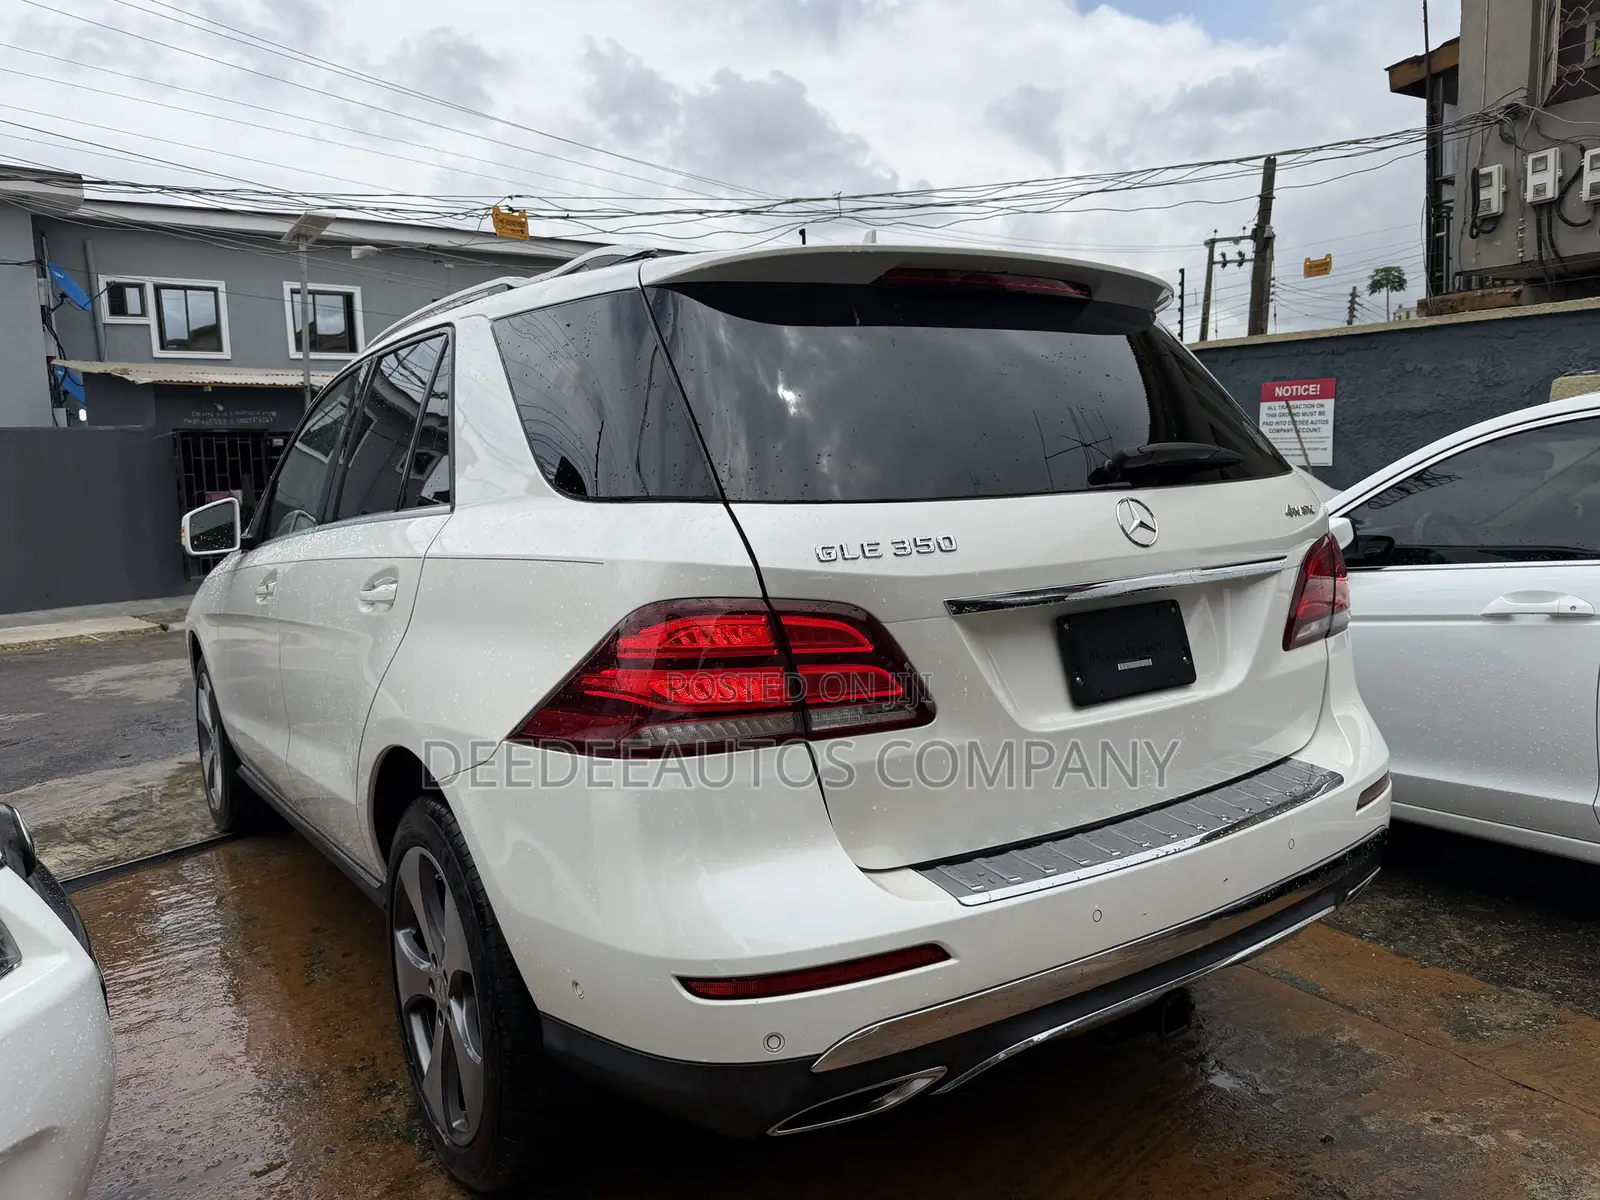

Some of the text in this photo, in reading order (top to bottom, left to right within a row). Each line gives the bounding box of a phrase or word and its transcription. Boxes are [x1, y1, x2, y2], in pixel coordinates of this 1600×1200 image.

[1274, 384, 1321, 397] NOTICE!
[814, 534, 957, 563] GLE 350
